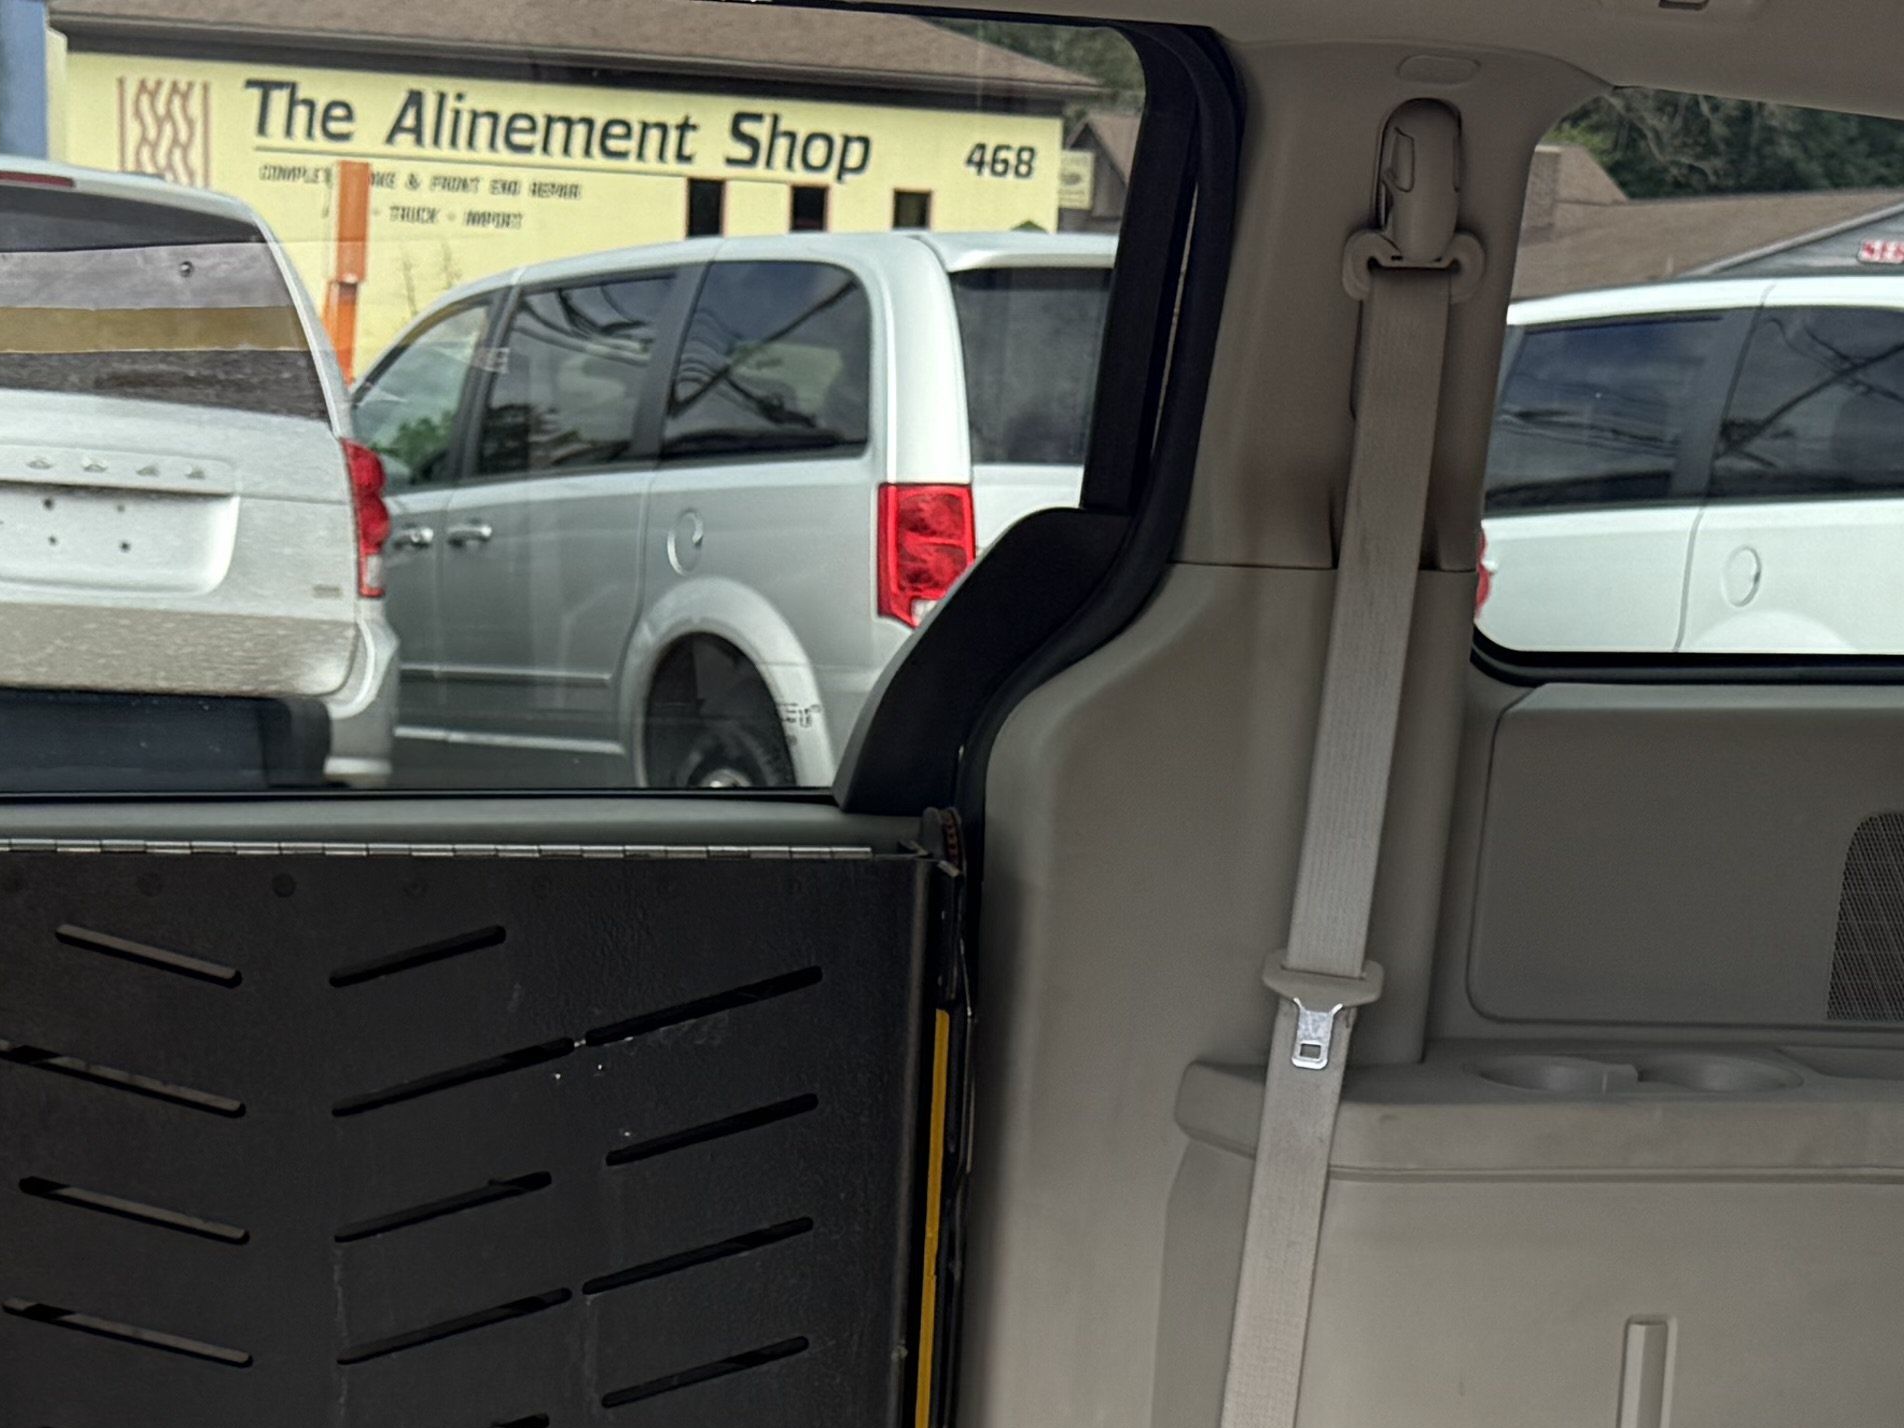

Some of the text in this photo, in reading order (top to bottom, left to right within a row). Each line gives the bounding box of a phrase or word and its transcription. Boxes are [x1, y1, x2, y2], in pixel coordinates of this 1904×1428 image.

[244, 78, 872, 183] The Alinement Shop
[965, 141, 1037, 179] 468
[389, 205, 440, 225] TRUCK
